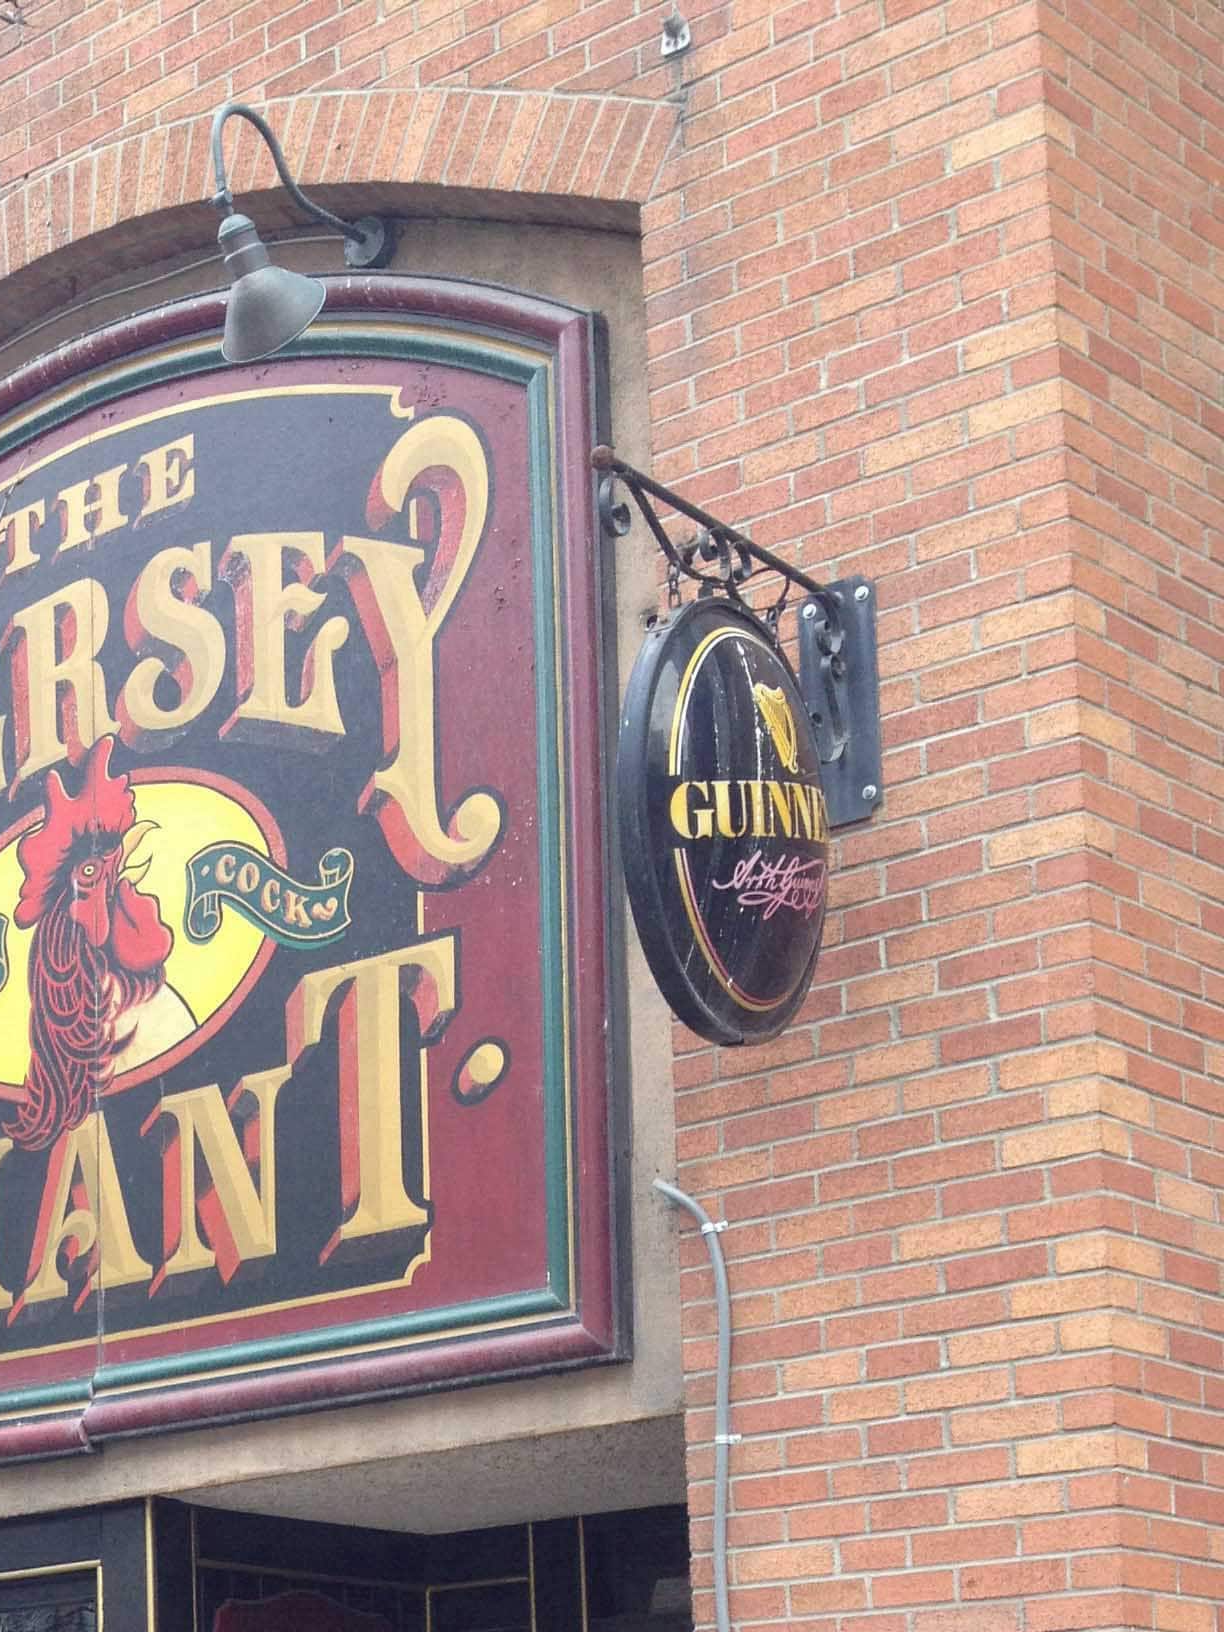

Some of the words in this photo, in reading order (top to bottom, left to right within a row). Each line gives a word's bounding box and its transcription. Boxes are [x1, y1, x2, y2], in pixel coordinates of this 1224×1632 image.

[1, 434, 196, 576] THE
[669, 779, 829, 843] GUINNE
[214, 854, 313, 928] COCK
